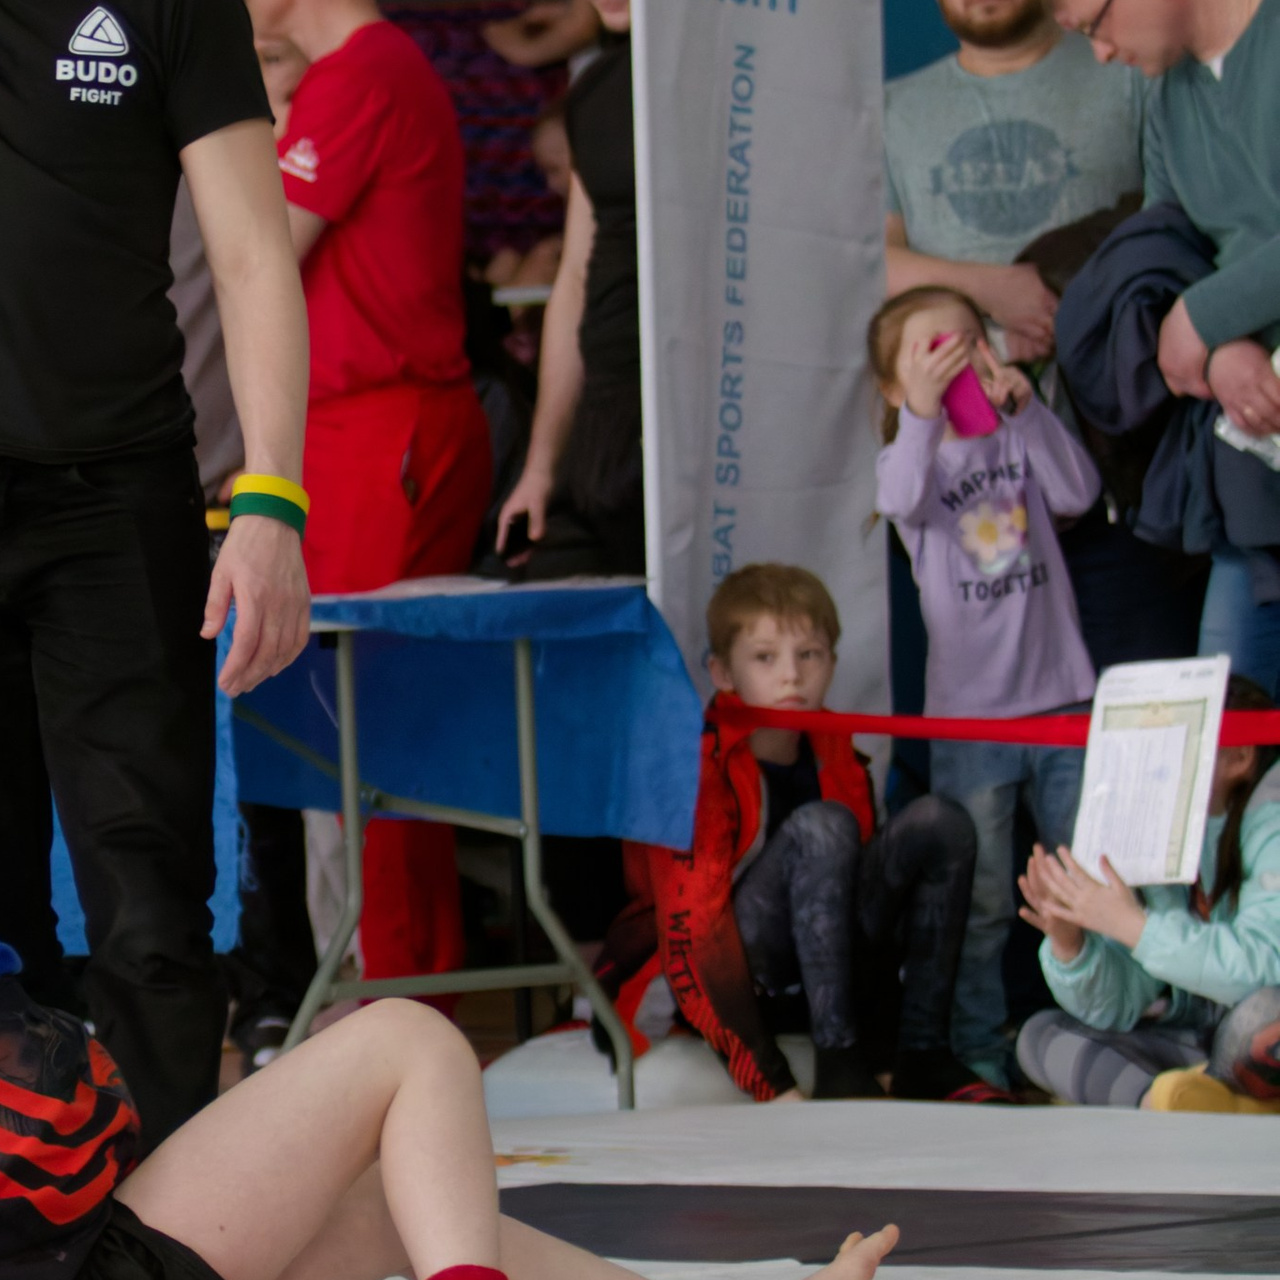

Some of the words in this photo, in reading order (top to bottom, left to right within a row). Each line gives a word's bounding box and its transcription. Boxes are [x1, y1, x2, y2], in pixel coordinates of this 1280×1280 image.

[55, 59, 138, 87] BUDO
[70, 87, 122, 106] FIGHT
[724, 43, 756, 307] FEDERATION
[715, 320, 745, 487] SPORTS
